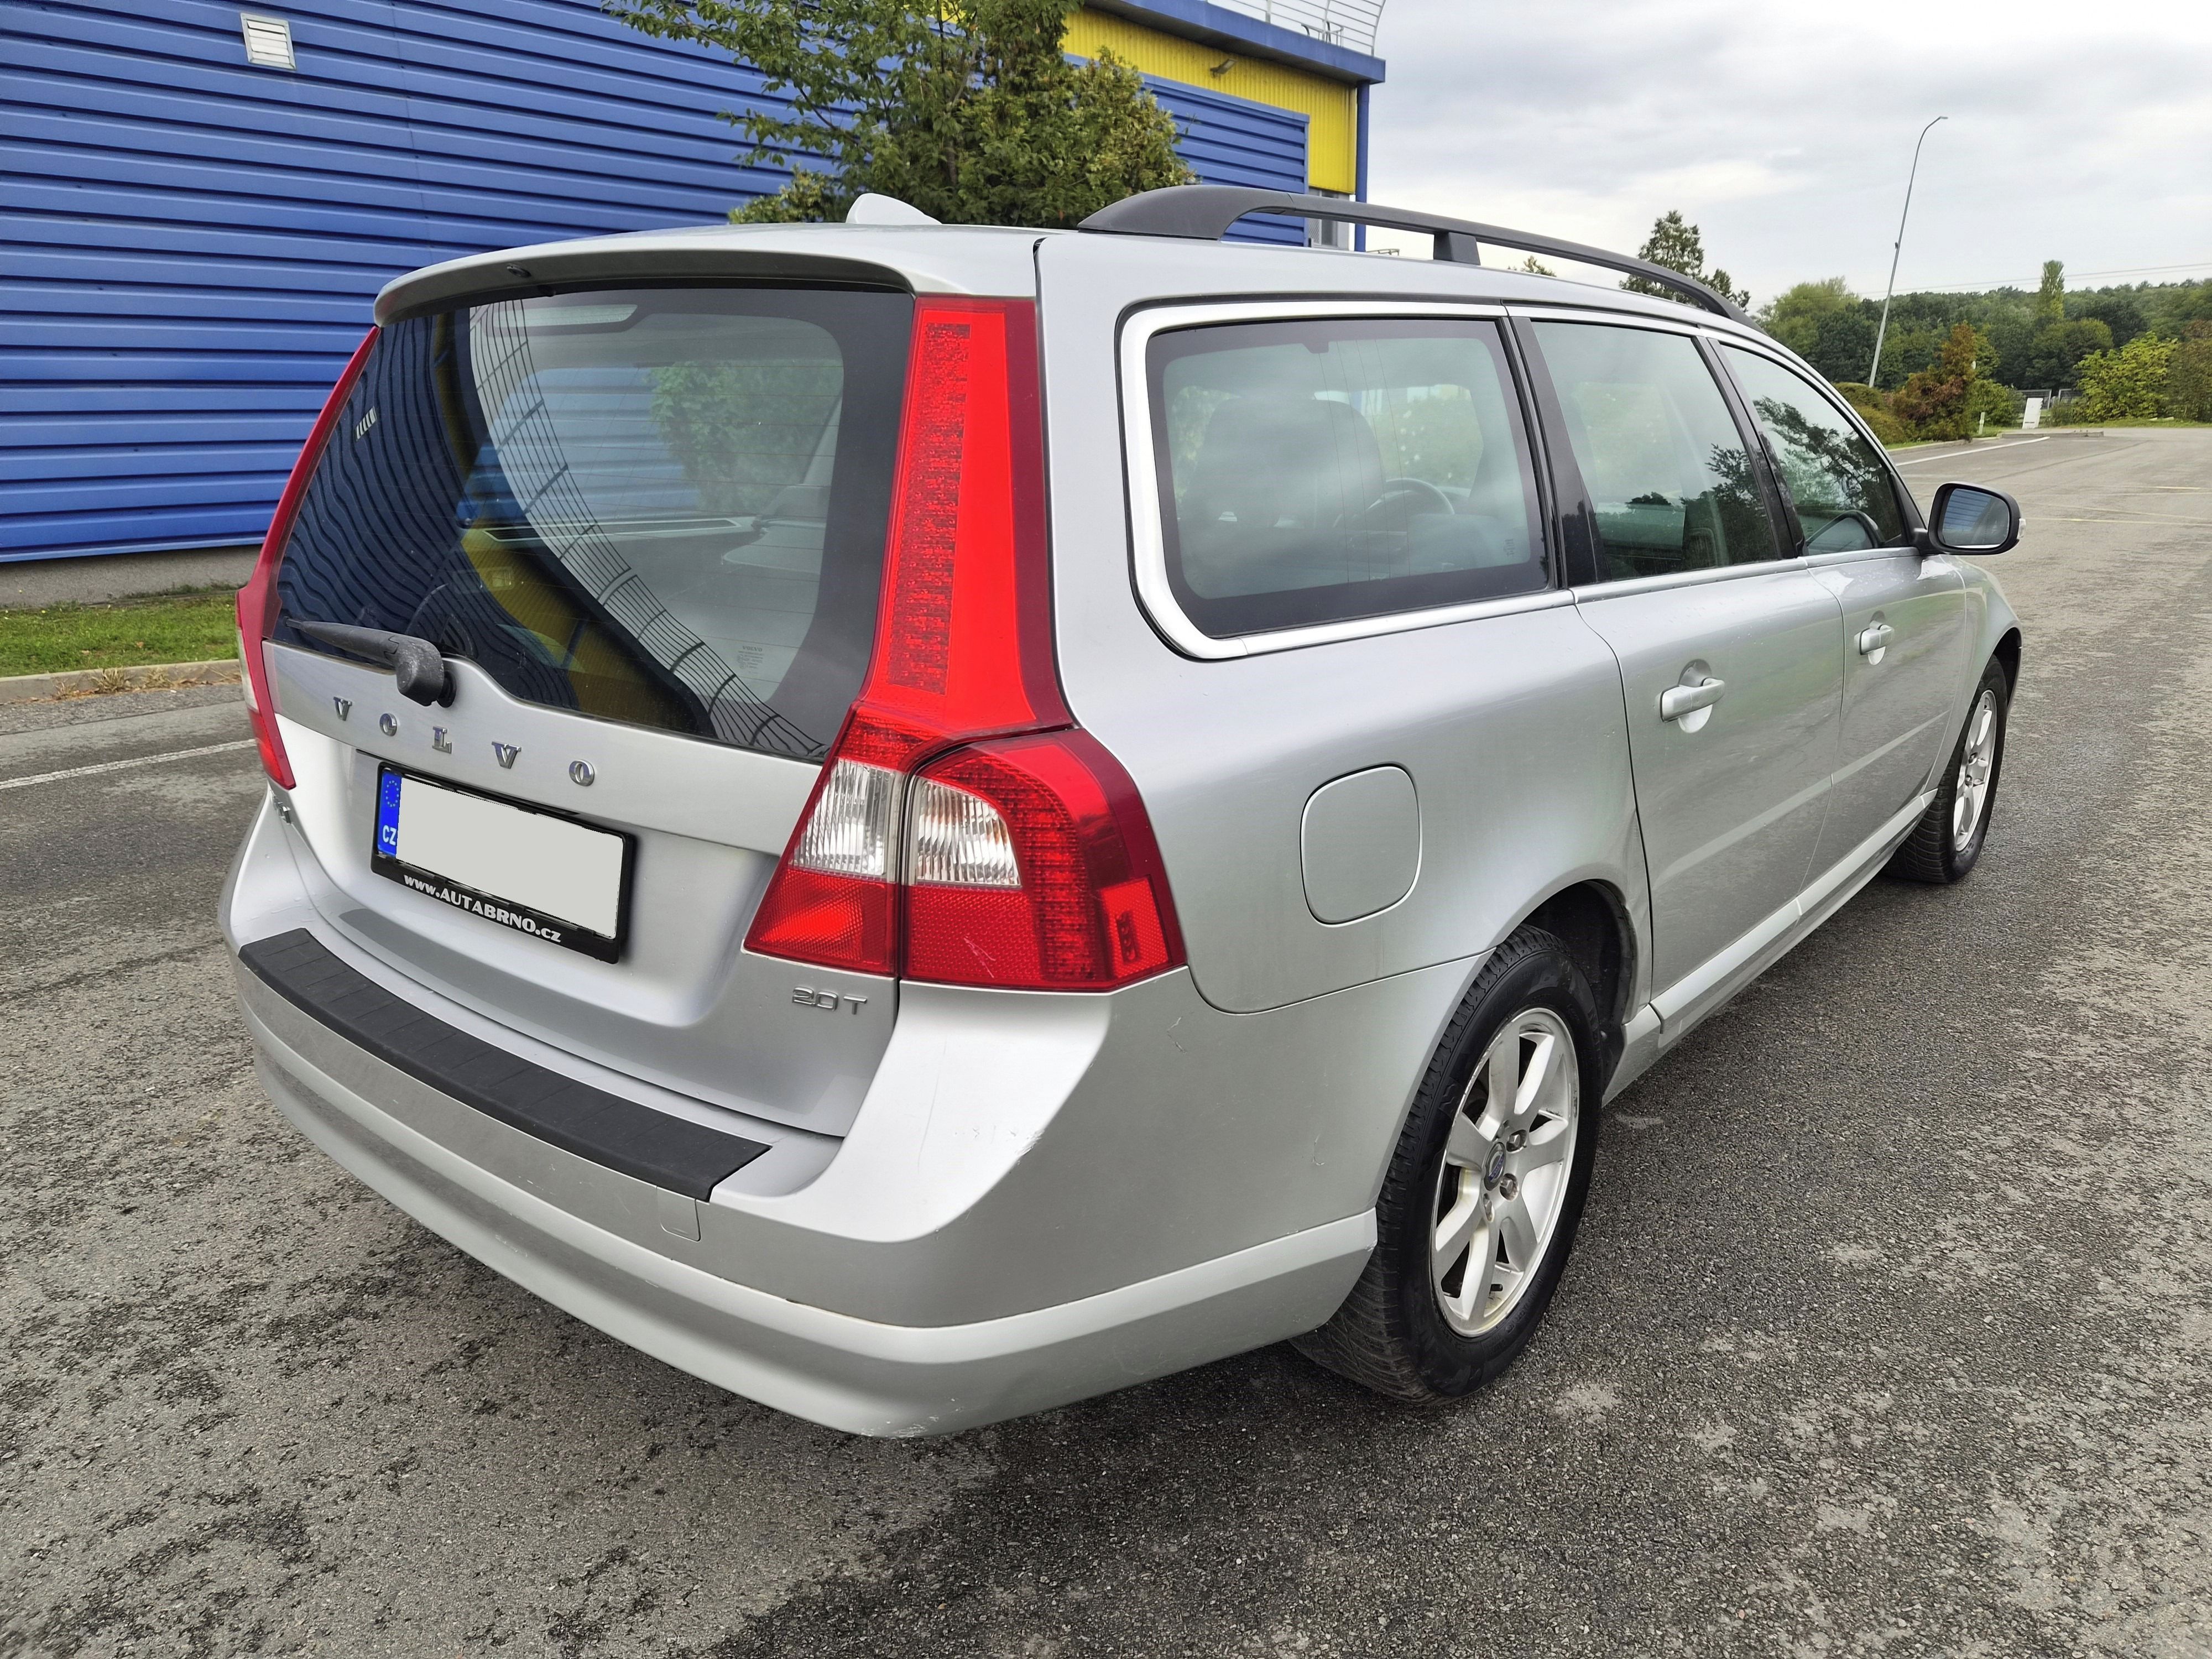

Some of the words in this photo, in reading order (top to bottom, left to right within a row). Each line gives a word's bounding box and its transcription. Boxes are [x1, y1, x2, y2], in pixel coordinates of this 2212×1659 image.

[333, 696, 594, 787] VOLVO
[383, 825, 397, 846] CZ
[404, 874, 561, 943] www.AUTABRNO.cz
